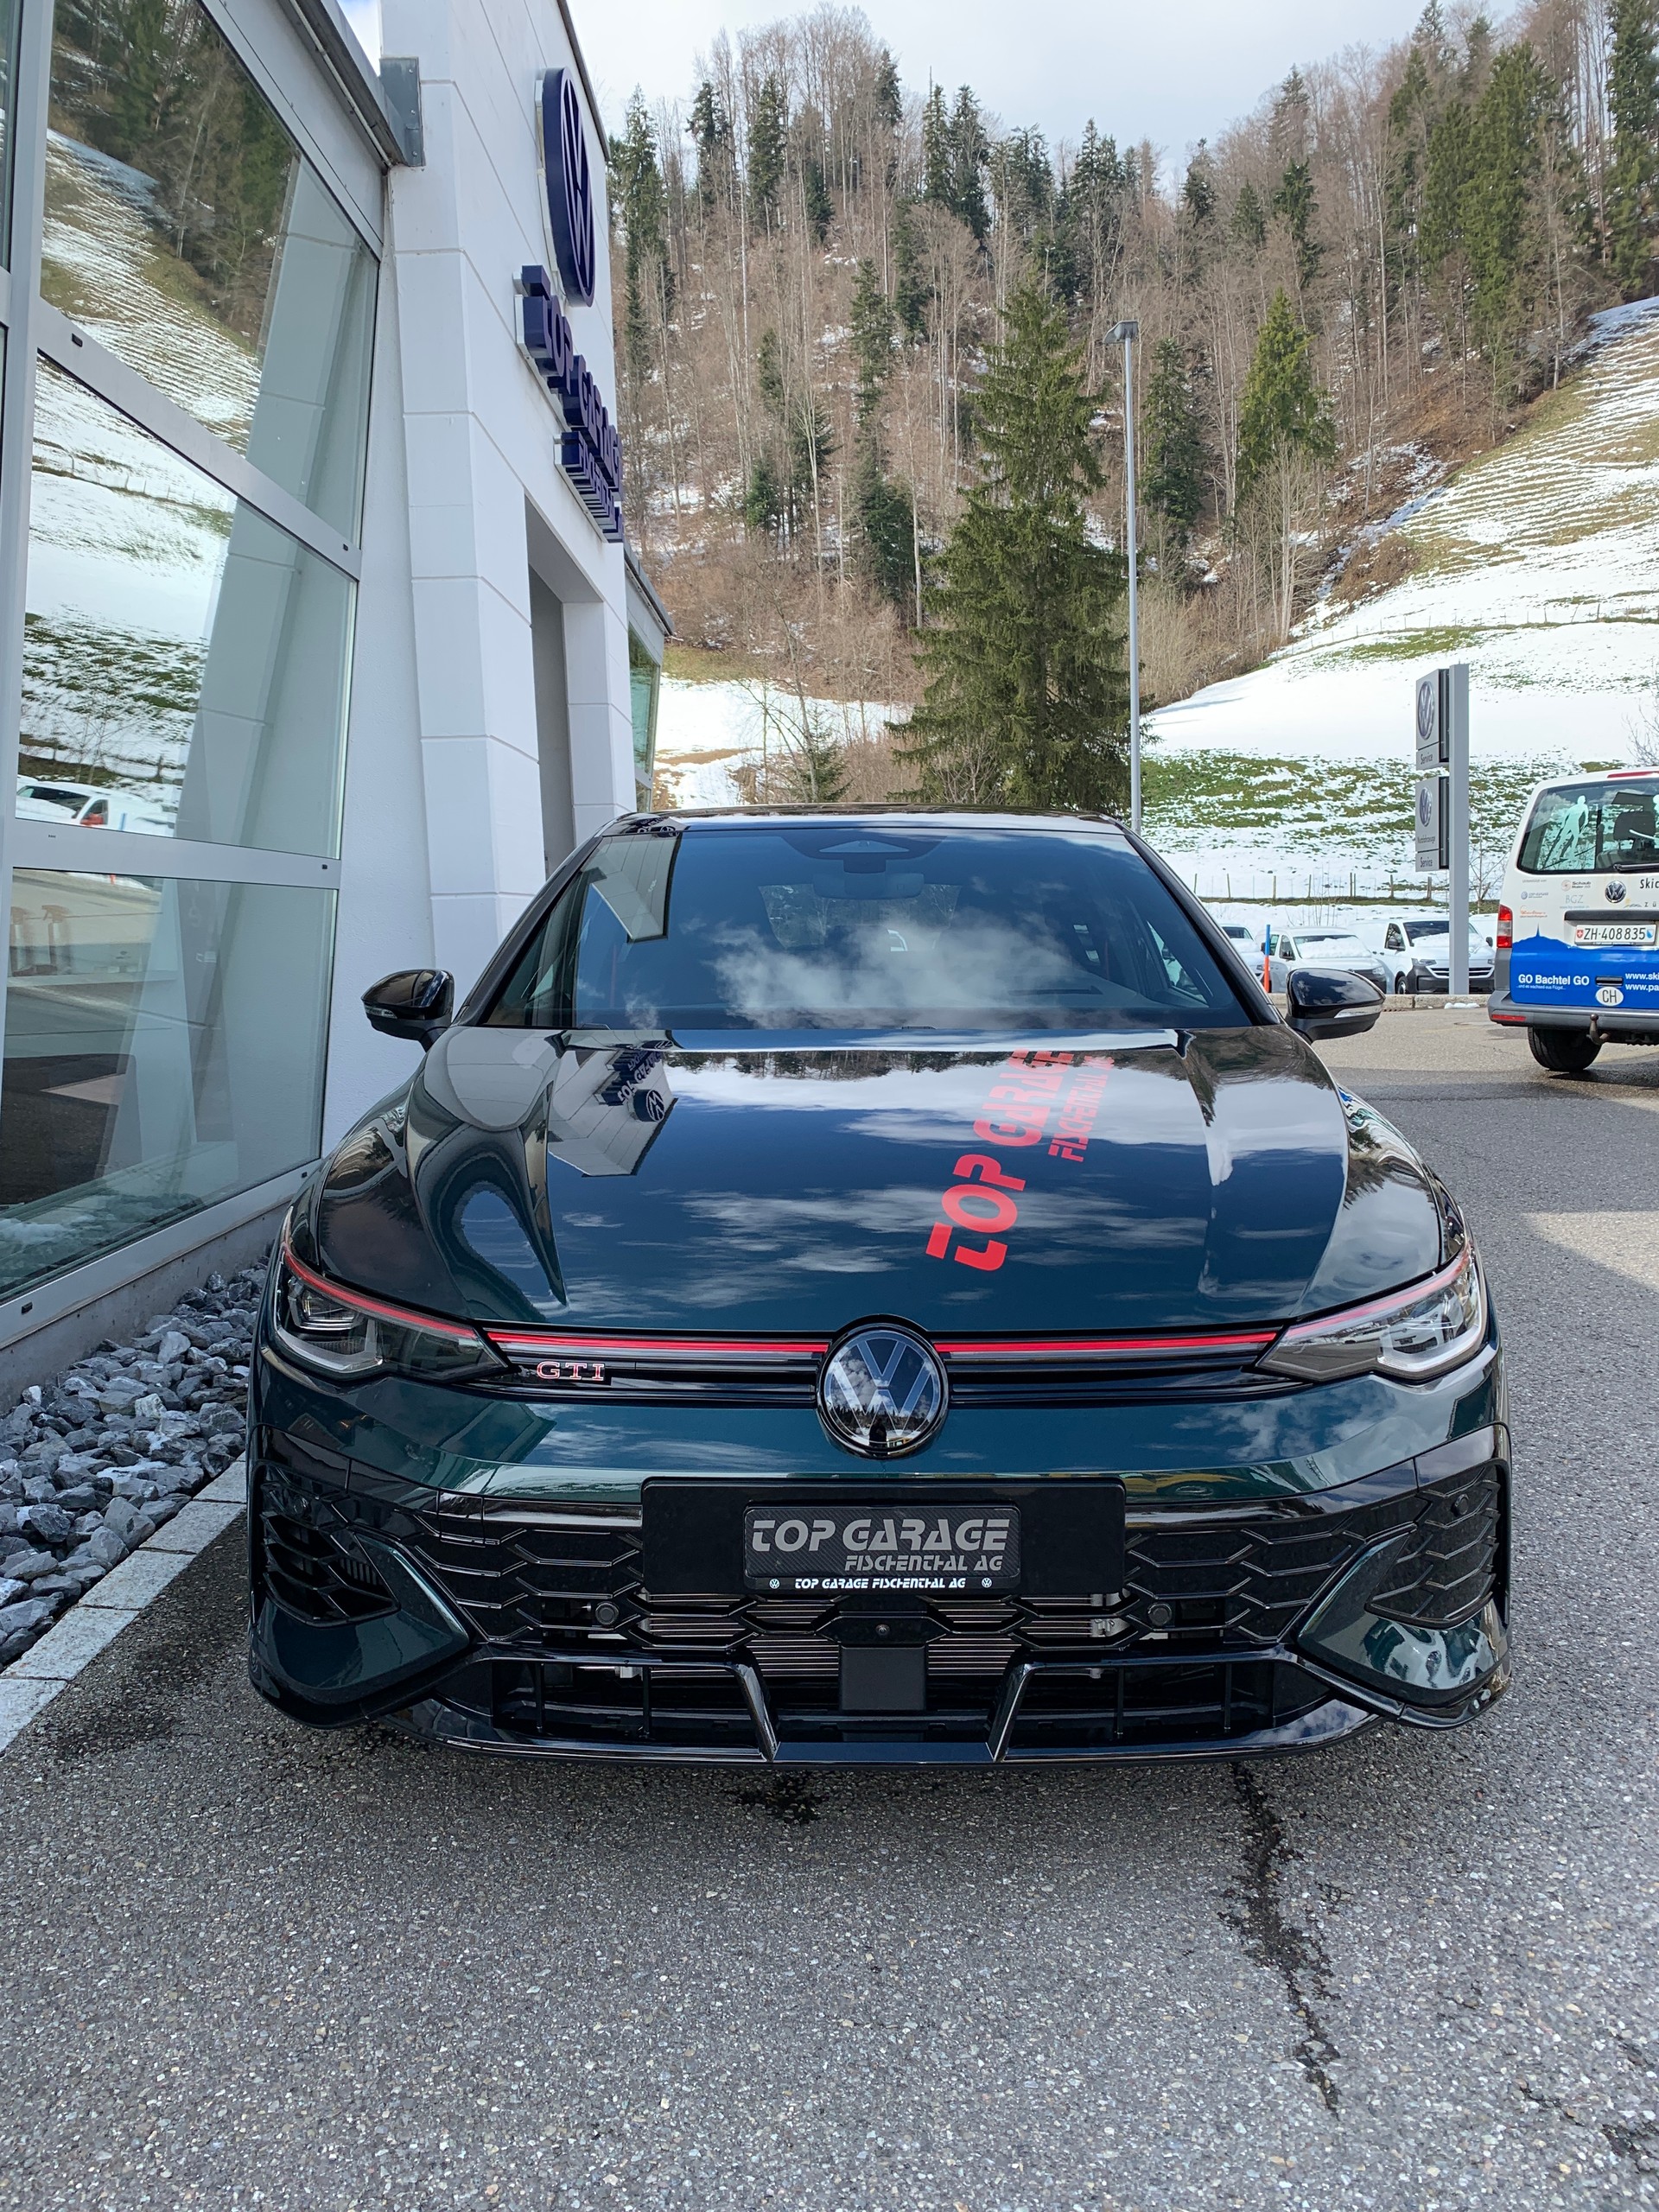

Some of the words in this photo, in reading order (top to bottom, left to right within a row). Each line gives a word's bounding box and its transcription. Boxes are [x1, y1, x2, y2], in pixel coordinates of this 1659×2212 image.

[525, 265, 574, 394] TOP
[571, 354, 623, 500] GARAG
[1420, 752, 1433, 765] Service
[1420, 856, 1433, 868] Service
[1566, 894, 1584, 904] BGZ
[1518, 974, 1533, 983] GO
[1535, 975, 1570, 985] Bachtel
[1573, 976, 1590, 986] GO
[1602, 989, 1617, 1003] CH
[973, 1048, 1074, 1147] GARAGE
[925, 1154, 1027, 1271] TOP
[537, 1361, 604, 1381] GTI
[752, 1519, 836, 1552] TOP
[842, 1518, 1010, 1551] GARAGE
[844, 1555, 969, 1571] FISCHENTHAL
[974, 1555, 1003, 1571] AG
[795, 1578, 819, 1589] TOP
[821, 1578, 869, 1589] GARAGE
[872, 1578, 946, 1589] FISCHENTHAL
[949, 1578, 966, 1588] AG
